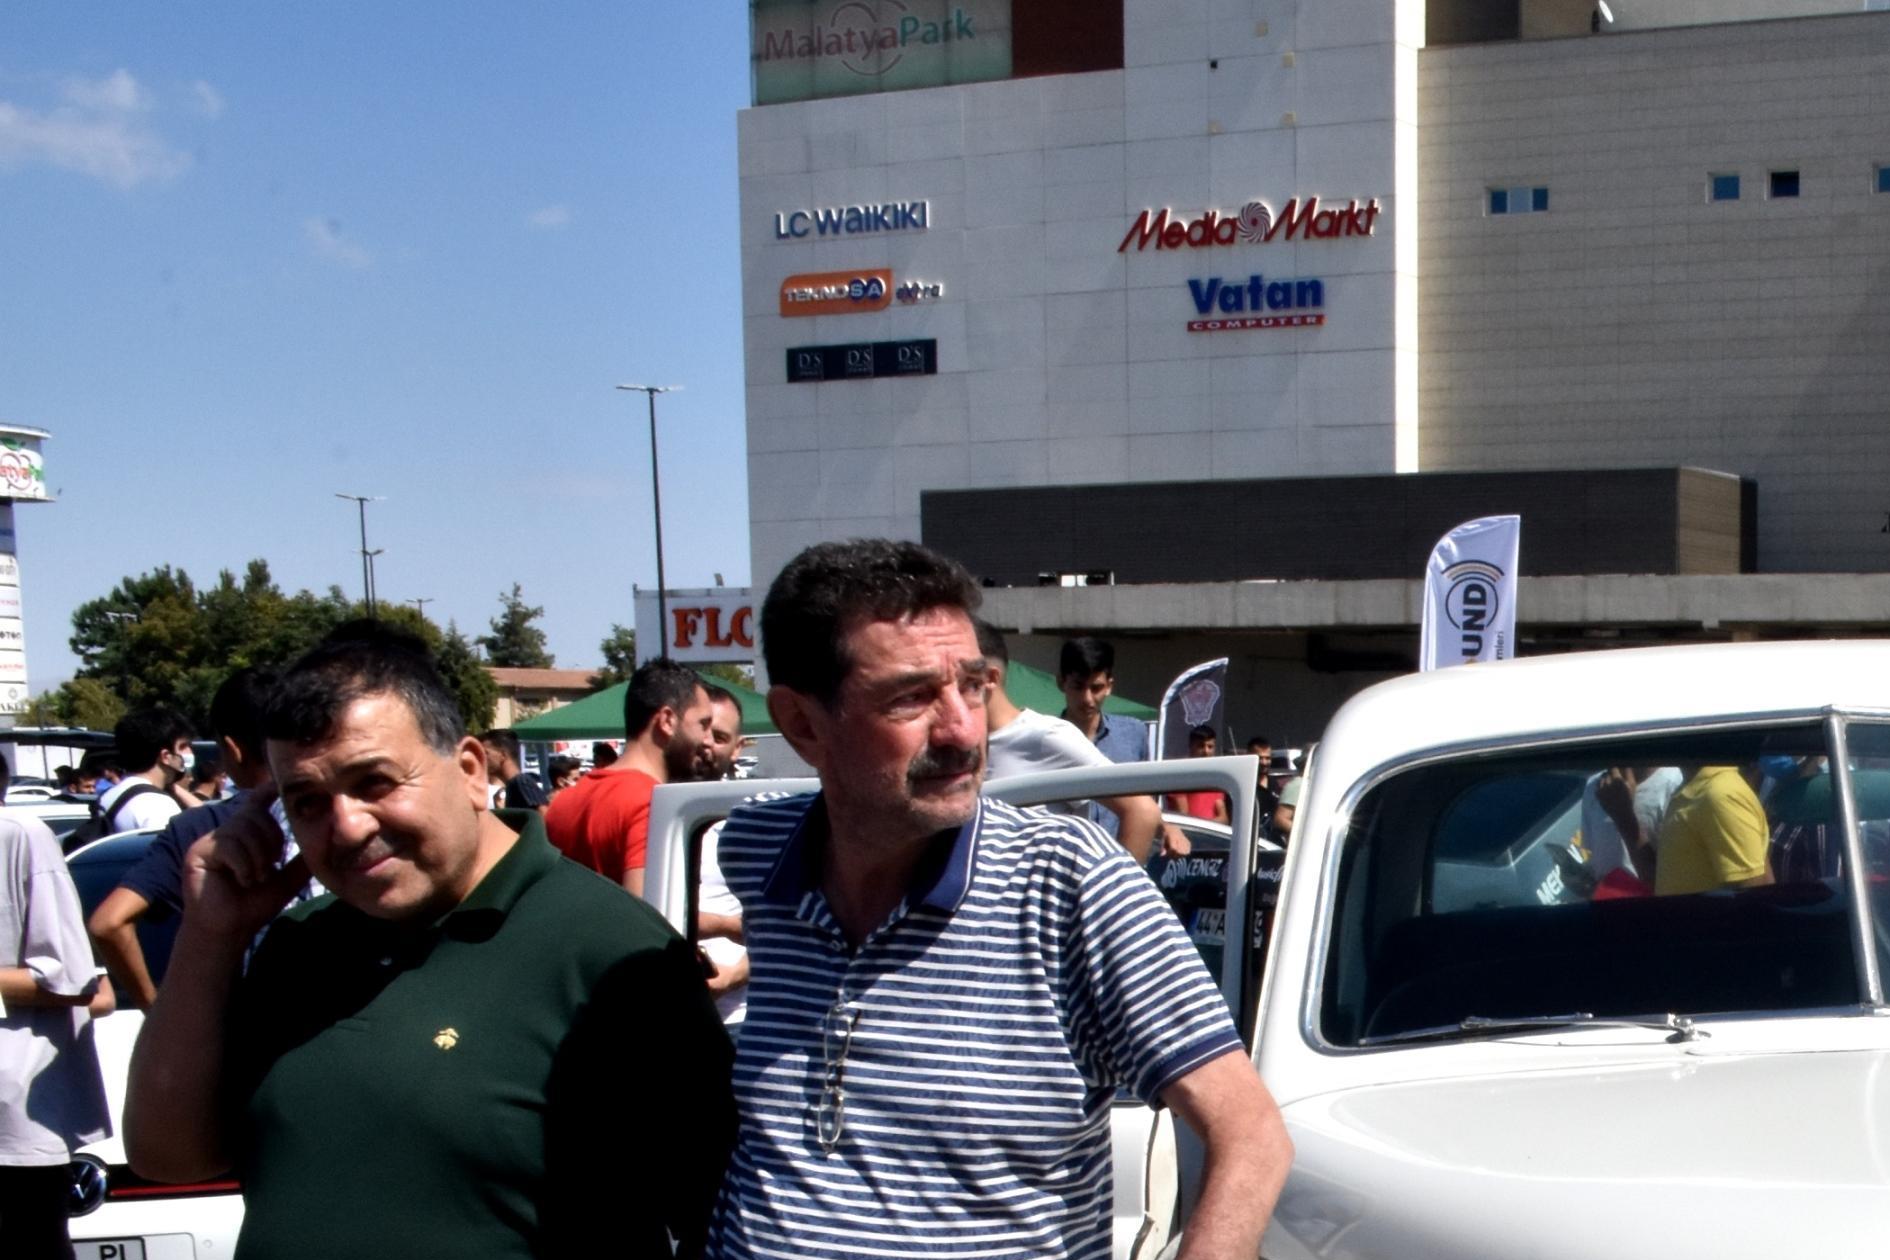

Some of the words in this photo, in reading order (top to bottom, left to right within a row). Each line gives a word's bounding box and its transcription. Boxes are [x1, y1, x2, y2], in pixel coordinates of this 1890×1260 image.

[775, 211, 811, 240] LC
[1118, 208, 1240, 252] Media
[1263, 197, 1381, 243] Markt
[785, 277, 886, 302] TEKNOSA
[1187, 275, 1325, 314] Vatan
[1191, 317, 1318, 330] COMPUTER
[1462, 583, 1487, 666] UND
